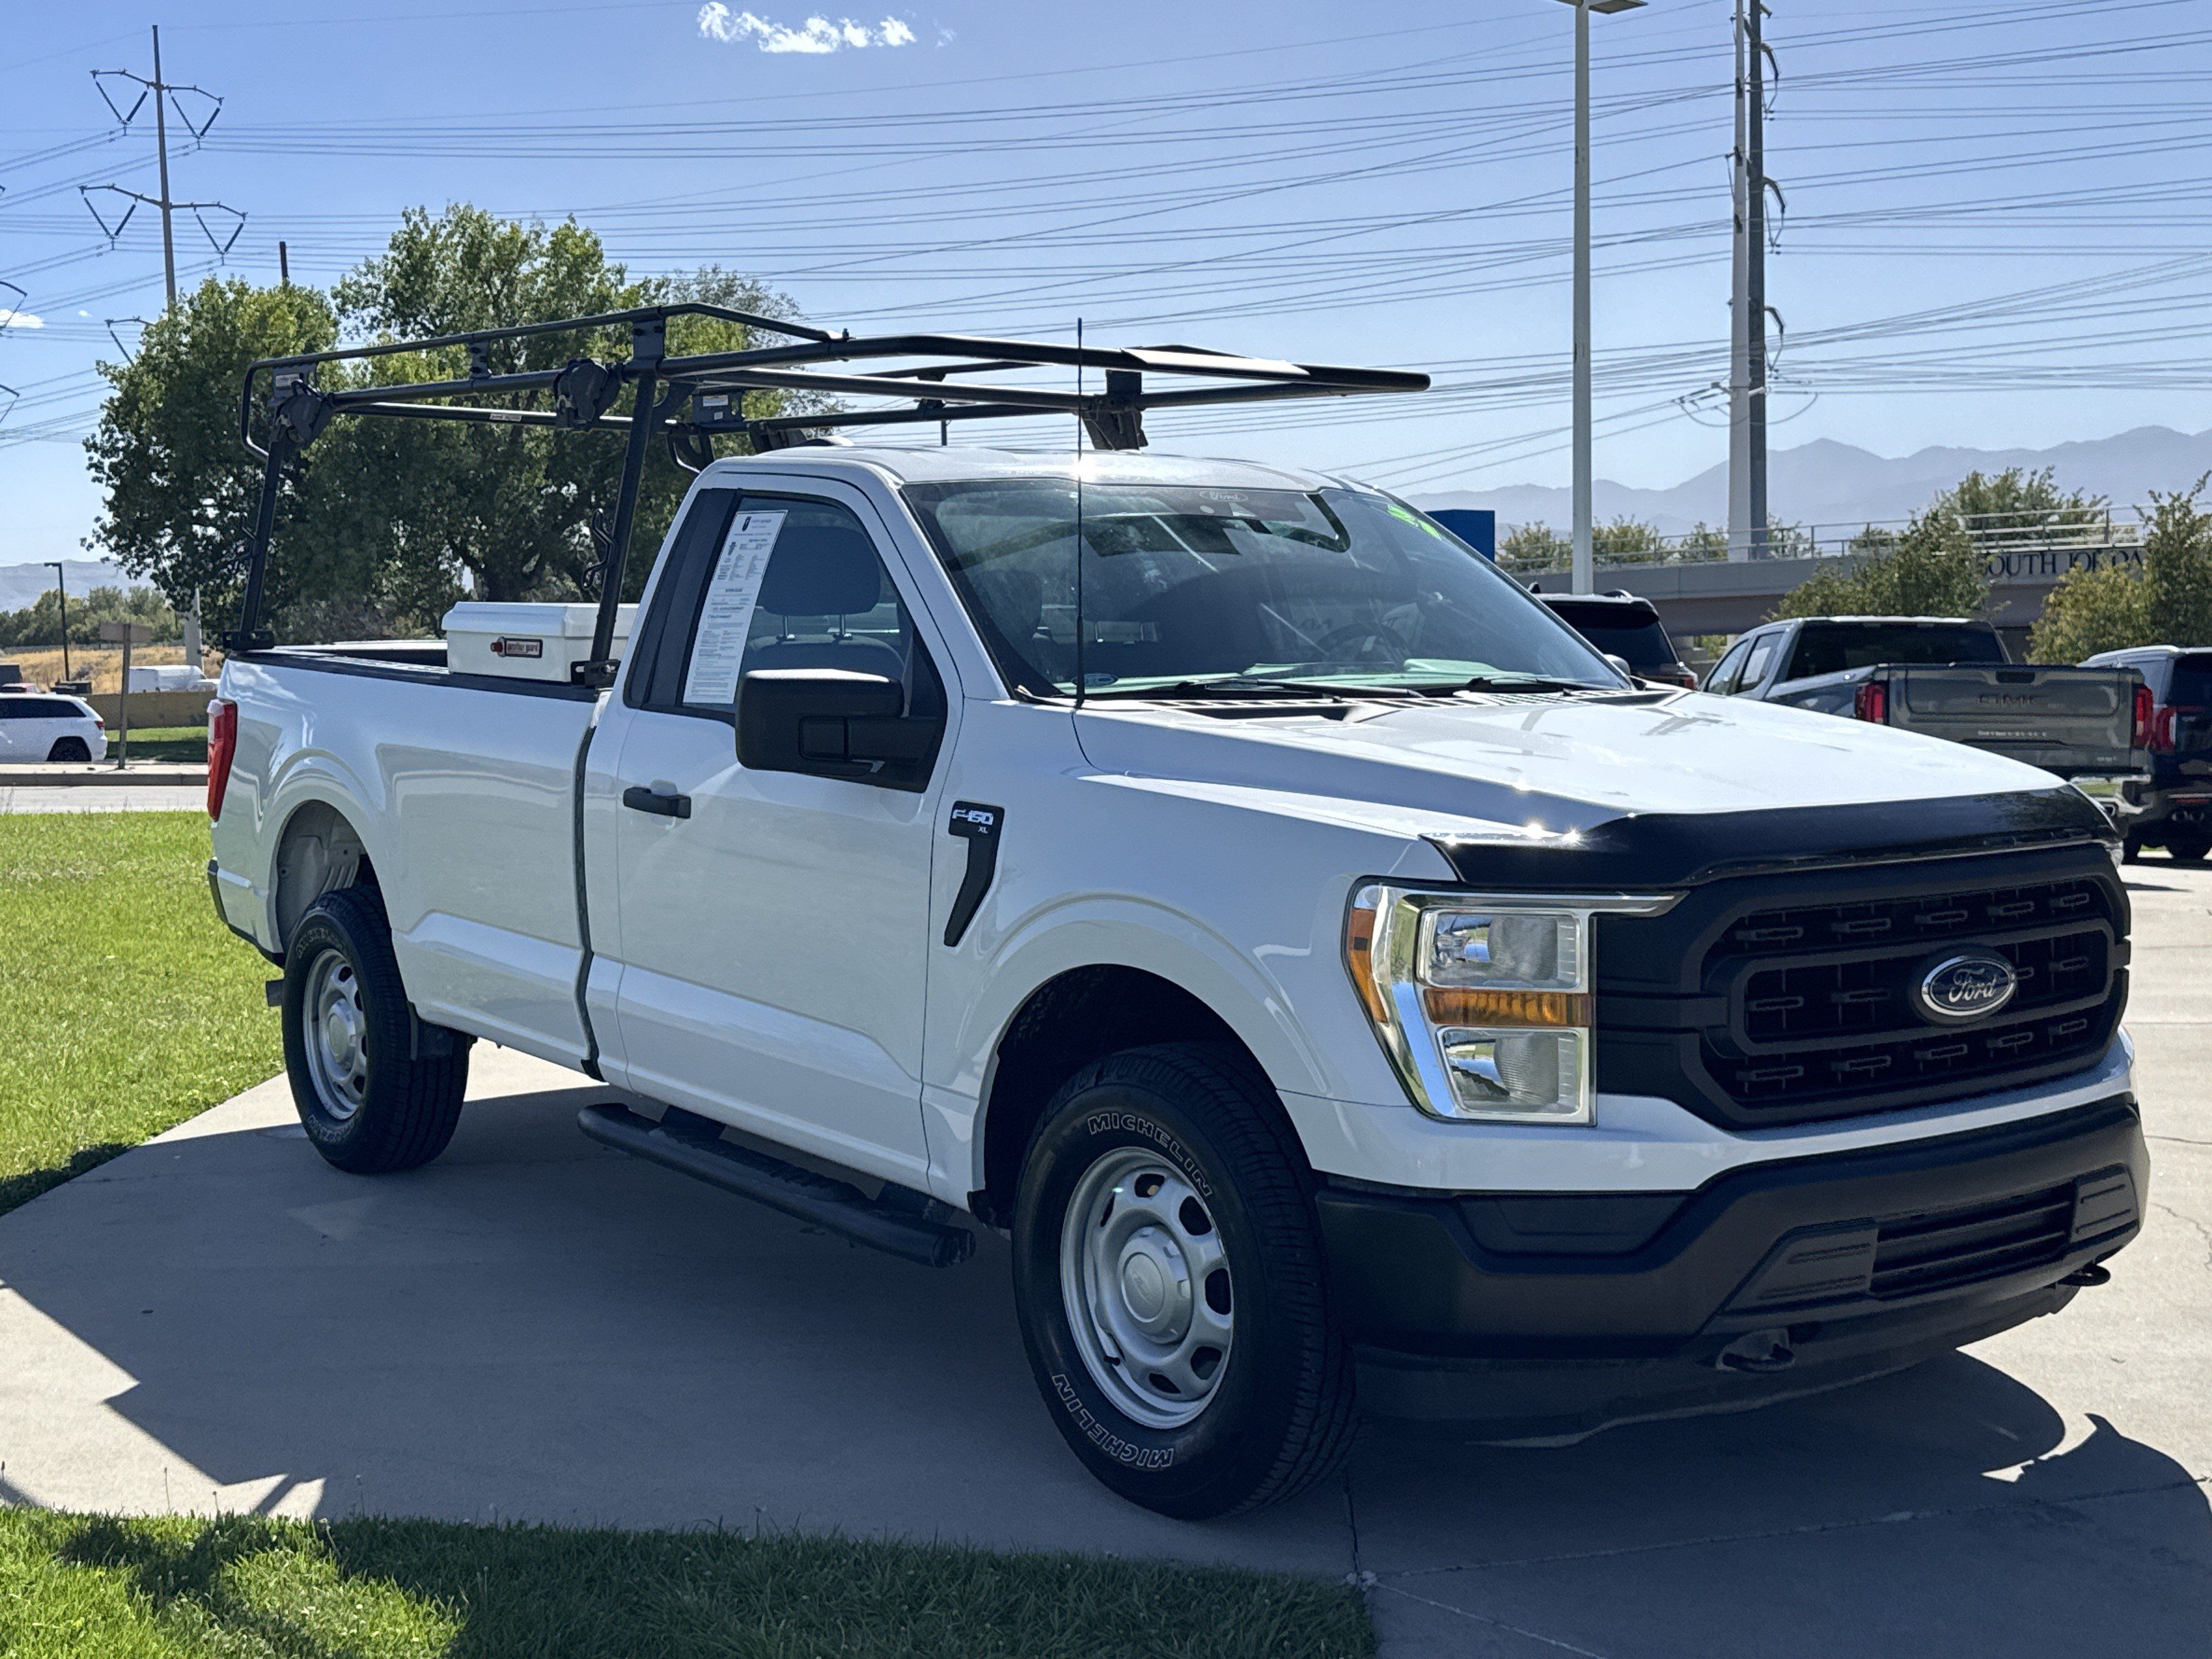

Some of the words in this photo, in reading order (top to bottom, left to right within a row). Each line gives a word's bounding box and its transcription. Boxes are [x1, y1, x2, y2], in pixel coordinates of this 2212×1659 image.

[2064, 550, 2143, 573] JODA
[1948, 968, 1997, 1003] Ford
[1087, 1113, 1213, 1197] MICHELIN
[1051, 1373, 1175, 1468] MICHELIN
